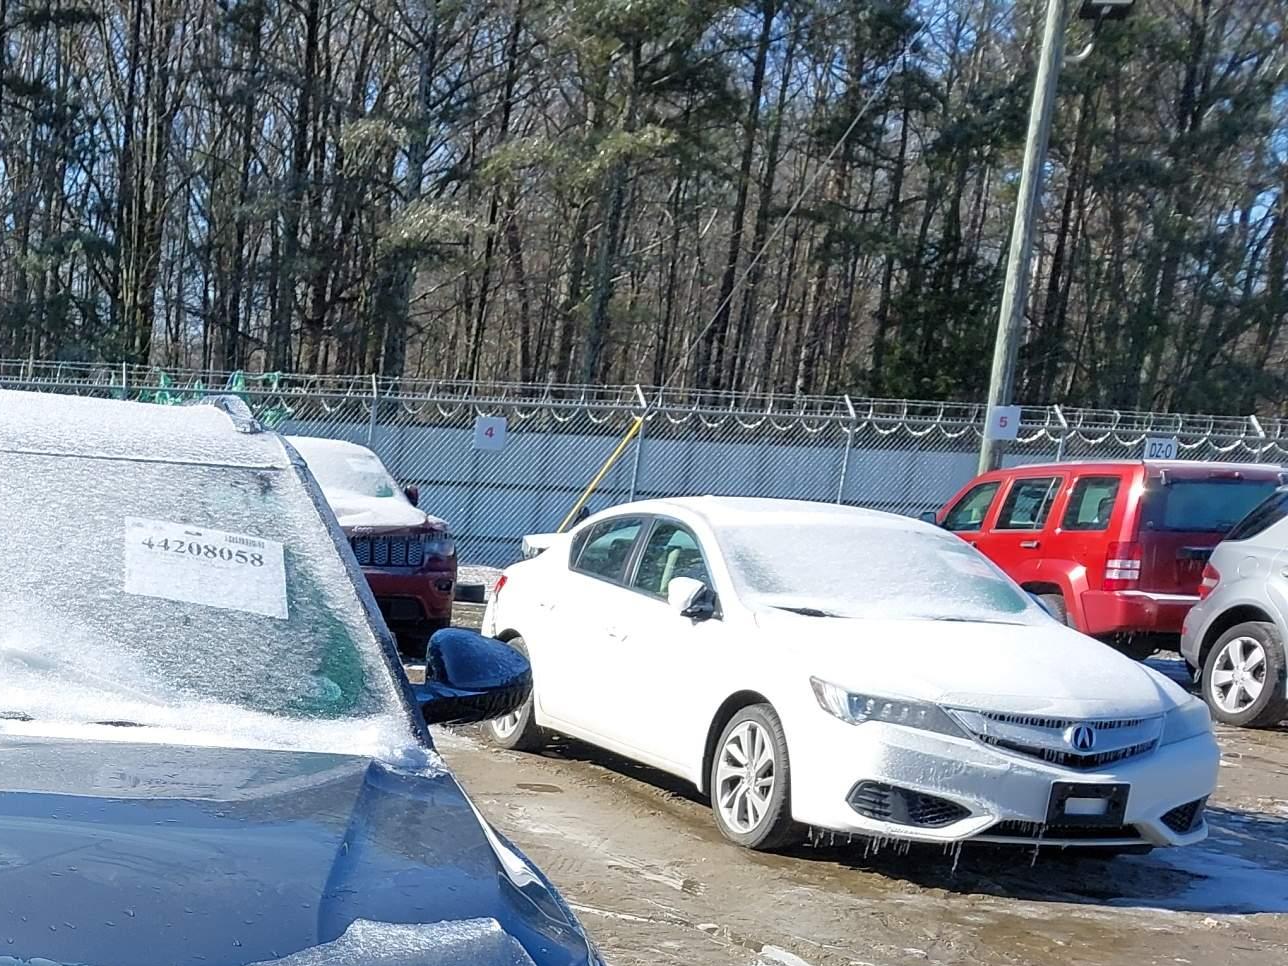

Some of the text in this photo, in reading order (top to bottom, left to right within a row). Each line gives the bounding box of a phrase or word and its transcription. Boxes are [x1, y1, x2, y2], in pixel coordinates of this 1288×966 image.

[999, 416, 1008, 428] 5
[484, 426, 494, 438] 4
[142, 536, 265, 568] 44208058
